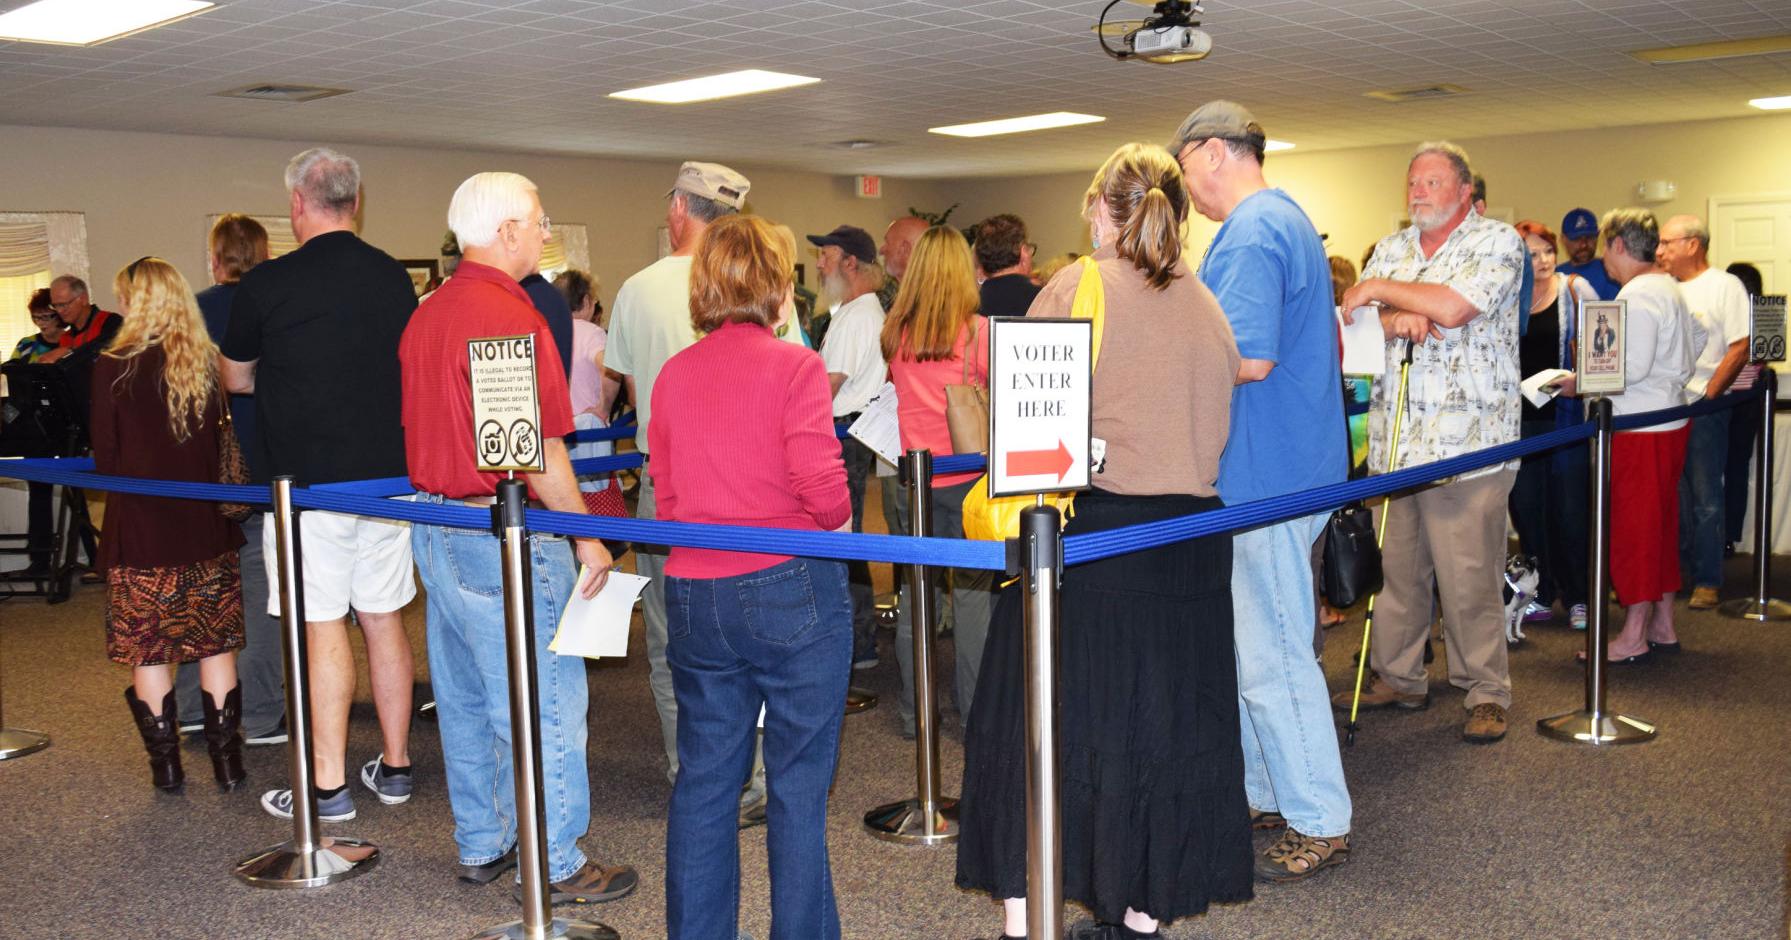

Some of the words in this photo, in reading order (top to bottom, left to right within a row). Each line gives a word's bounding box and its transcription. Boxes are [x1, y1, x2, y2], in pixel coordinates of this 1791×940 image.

[1753, 296, 1786, 305] NOTICE
[472, 340, 532, 361] NOTICE
[1012, 345, 1074, 361] VOTER
[1012, 373, 1072, 389] ENTER
[1018, 400, 1066, 417] HERE
